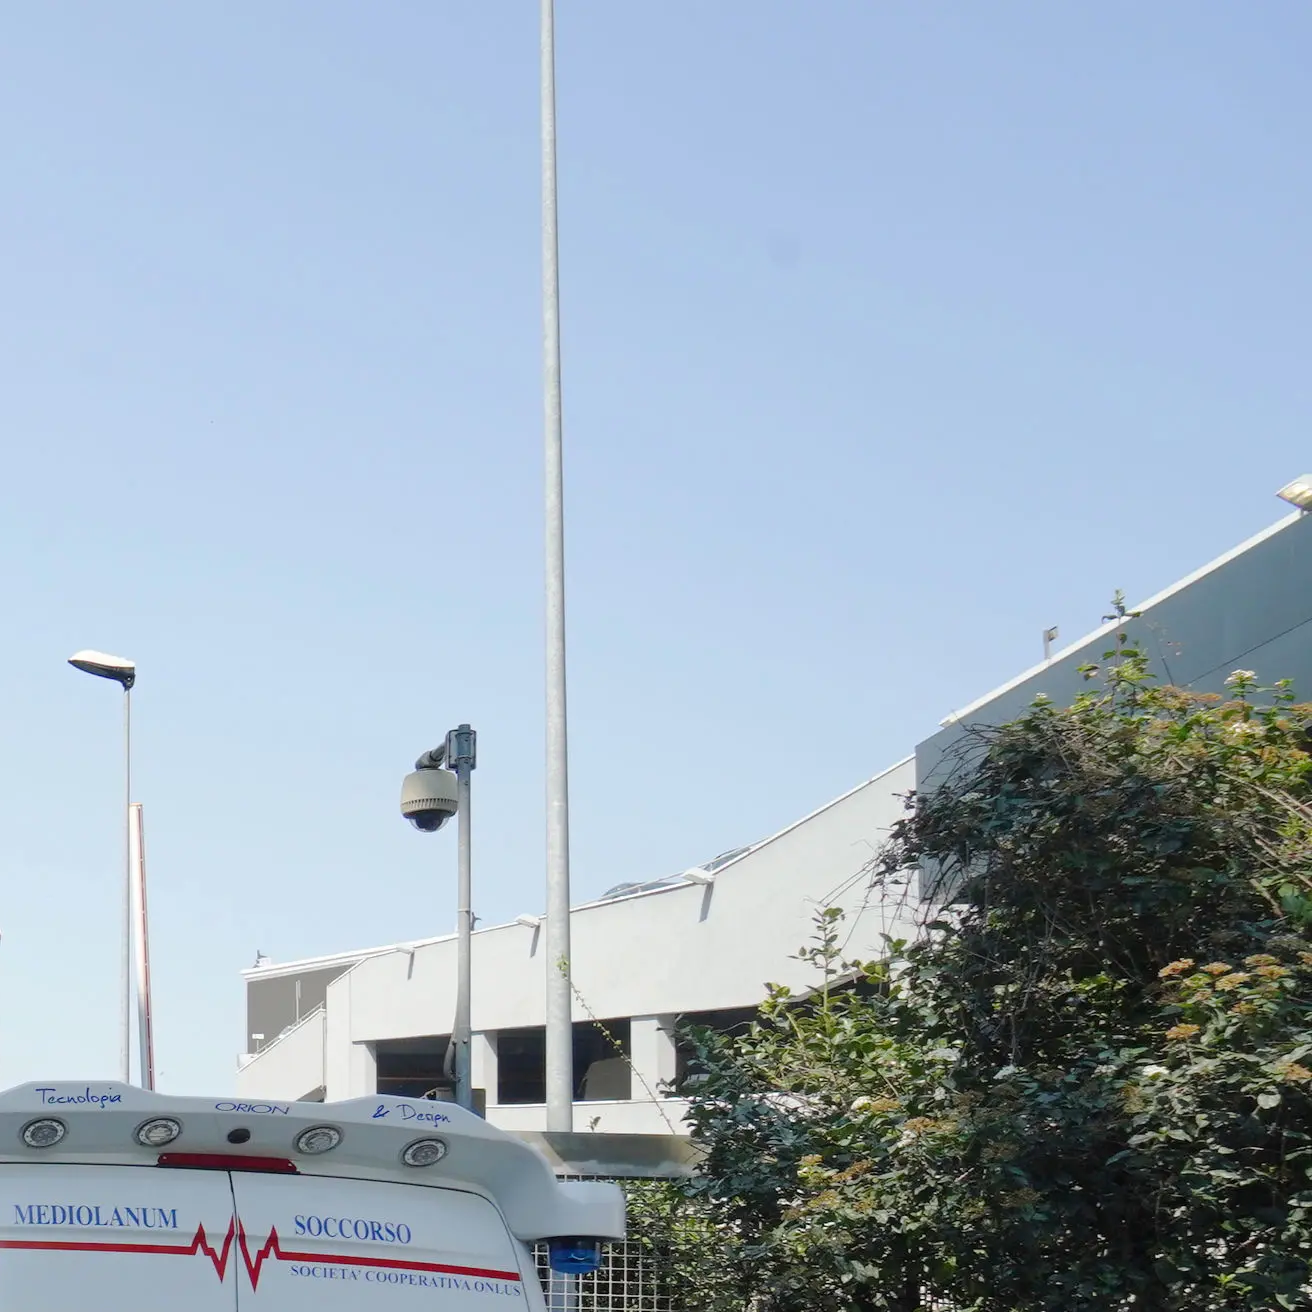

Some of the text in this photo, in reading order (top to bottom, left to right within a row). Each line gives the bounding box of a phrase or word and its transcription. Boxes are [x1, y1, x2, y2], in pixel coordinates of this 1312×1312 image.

[35, 1087, 122, 1109] Tecnologia
[215, 1102, 290, 1115] ORION
[372, 1104, 451, 1127] & Design
[13, 1204, 179, 1229] MEDIOLANUM
[294, 1214, 412, 1244] SOCCORSO
[290, 1264, 522, 1297] SOCIETA' COOPERATIVA ONLUS
